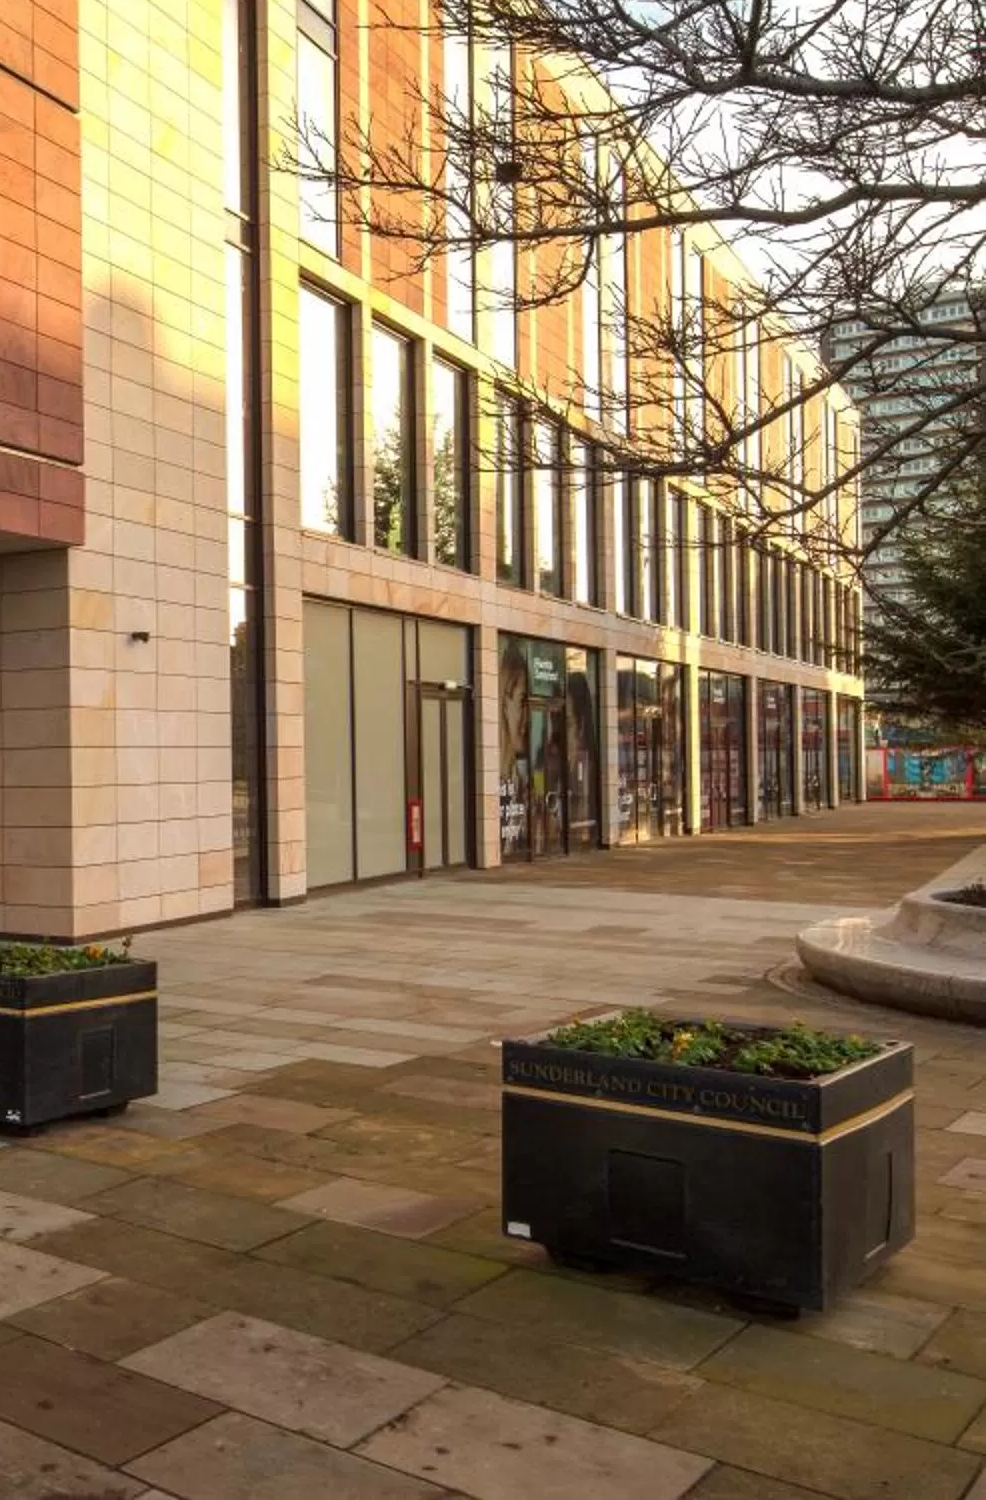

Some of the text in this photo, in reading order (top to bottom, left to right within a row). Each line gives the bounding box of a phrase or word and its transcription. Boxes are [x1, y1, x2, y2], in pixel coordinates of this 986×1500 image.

[509, 1059, 807, 1119] SUNDERLAND CITY COUNCIL
